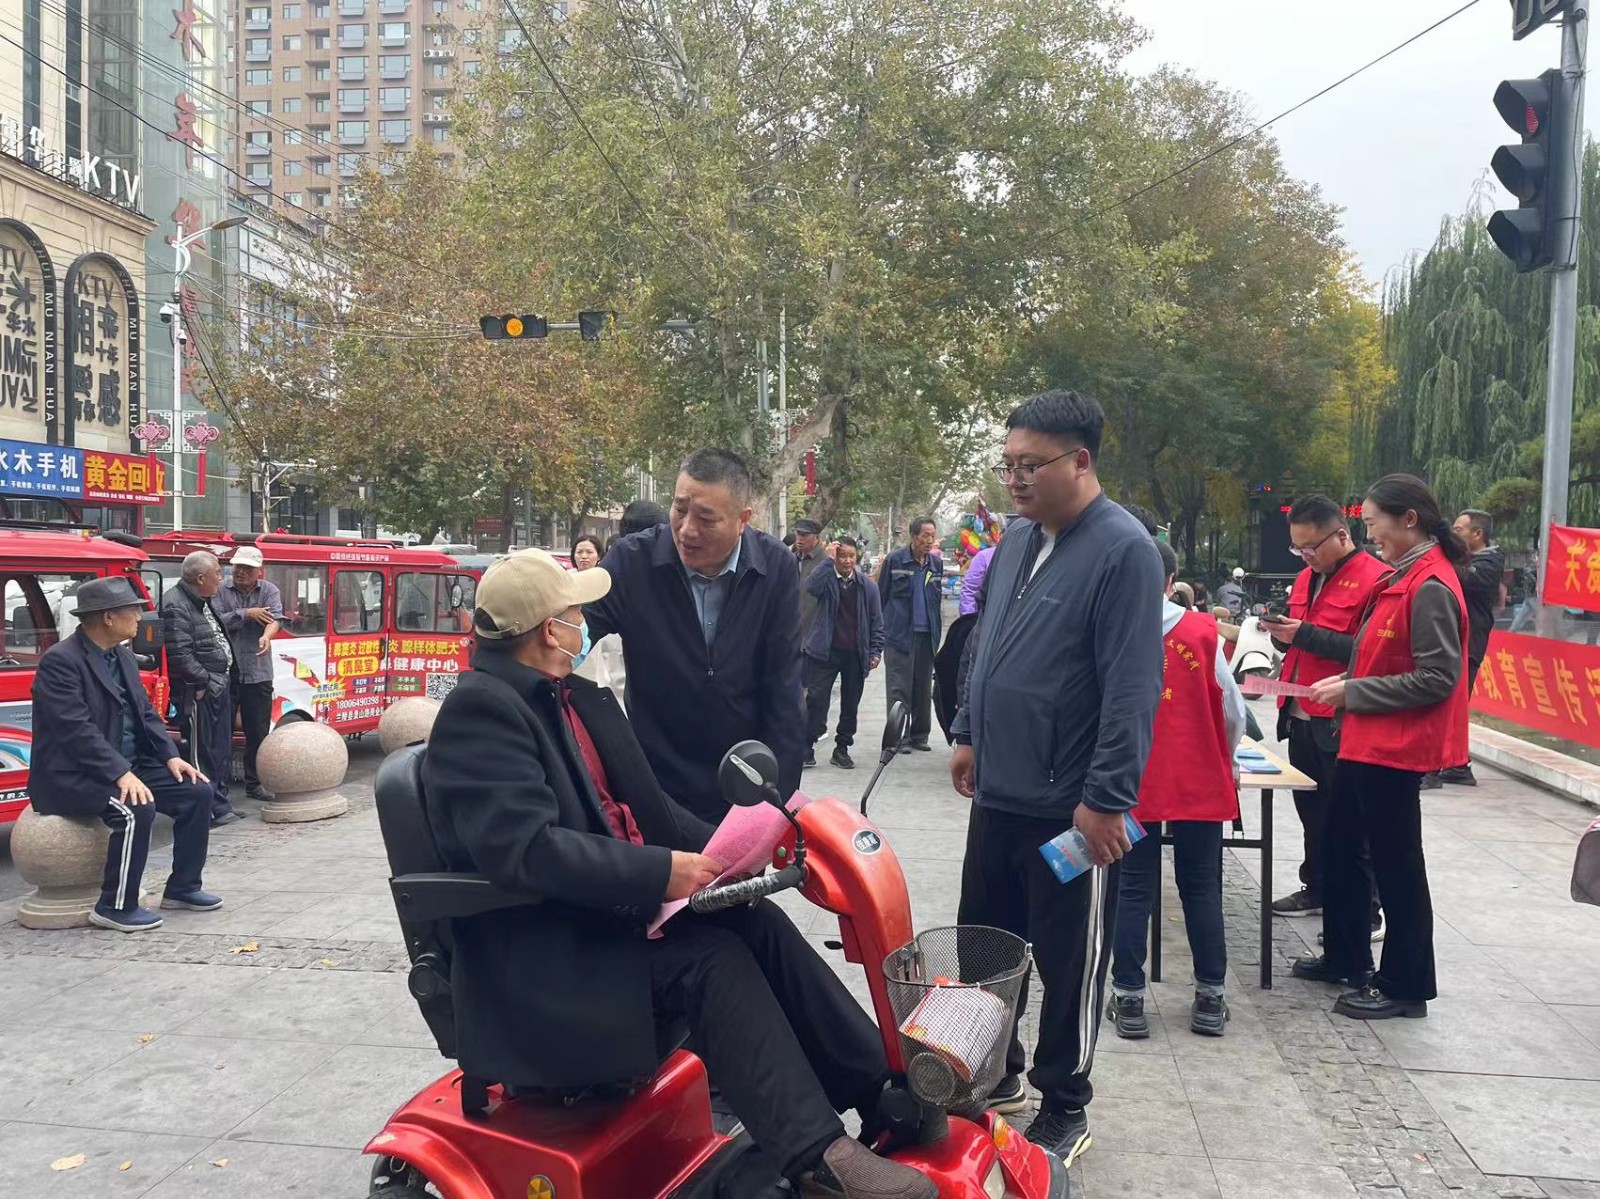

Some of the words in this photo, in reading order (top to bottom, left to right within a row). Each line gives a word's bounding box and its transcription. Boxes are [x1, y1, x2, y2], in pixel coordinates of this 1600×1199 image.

[358, 639, 398, 655] 过敏性炎
[401, 639, 460, 656] 腺样体肥大
[1474, 648, 1600, 728] 教育宣传
